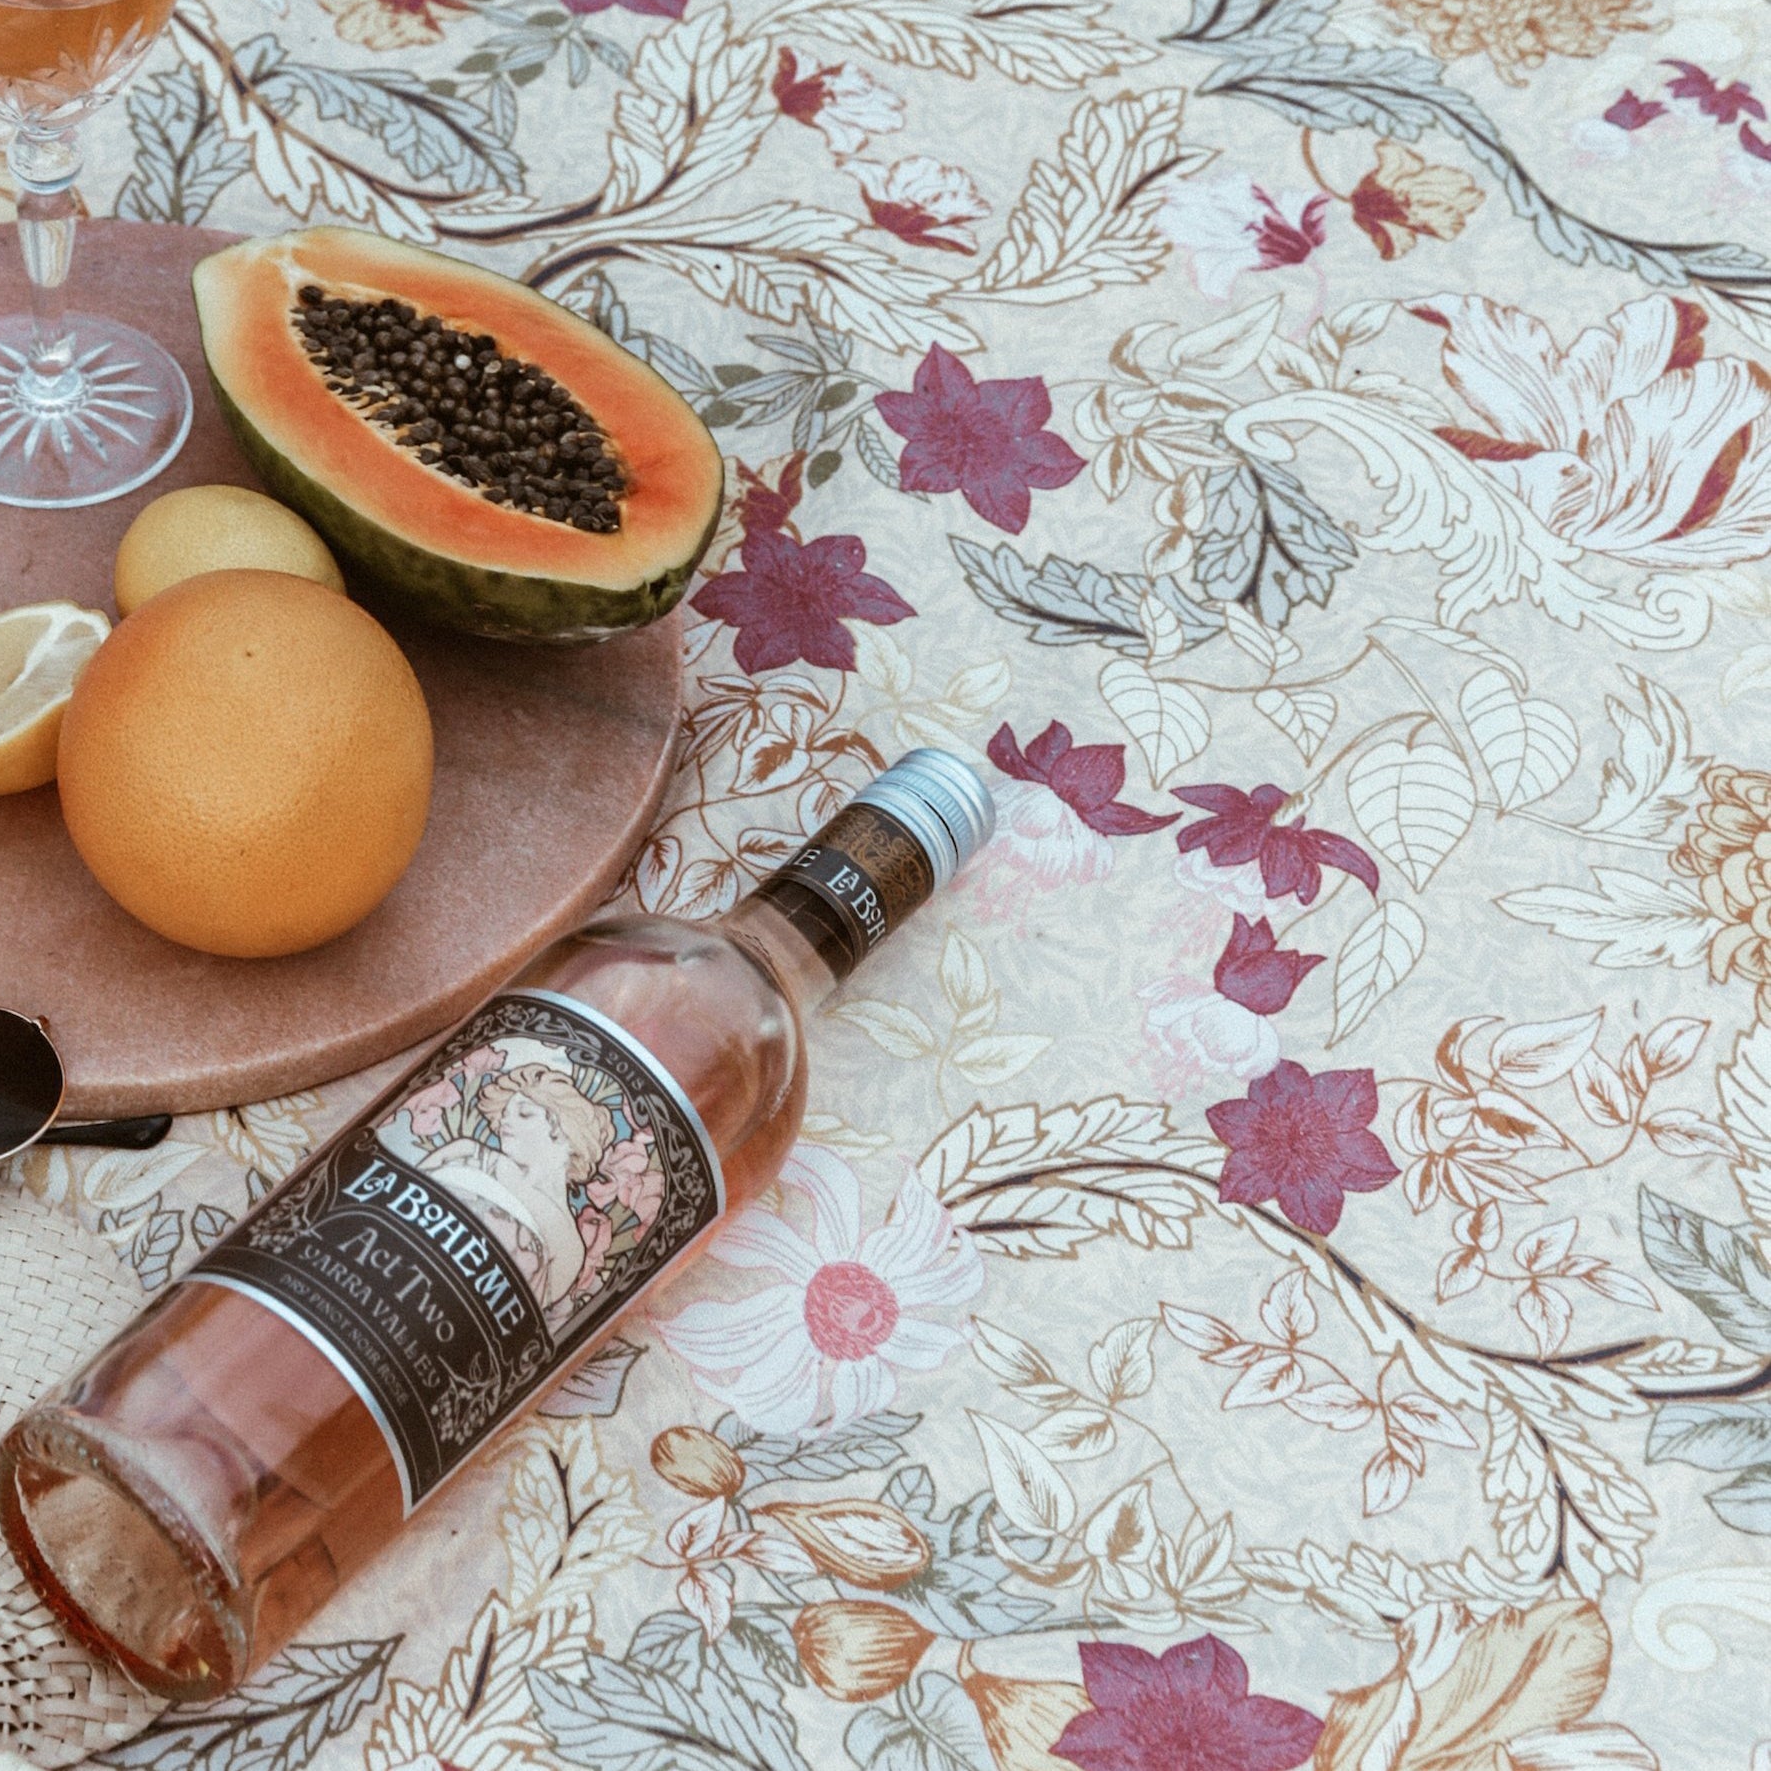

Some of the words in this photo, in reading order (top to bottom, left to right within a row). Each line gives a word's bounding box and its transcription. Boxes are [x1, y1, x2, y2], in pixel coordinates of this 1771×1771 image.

[604, 1051, 646, 1091] 2018
[298, 1244, 372, 1306] YARRA
[373, 1297, 441, 1388] VALLEY
[309, 1293, 352, 1330] PINOT
[348, 1329, 381, 1367] NOIR
